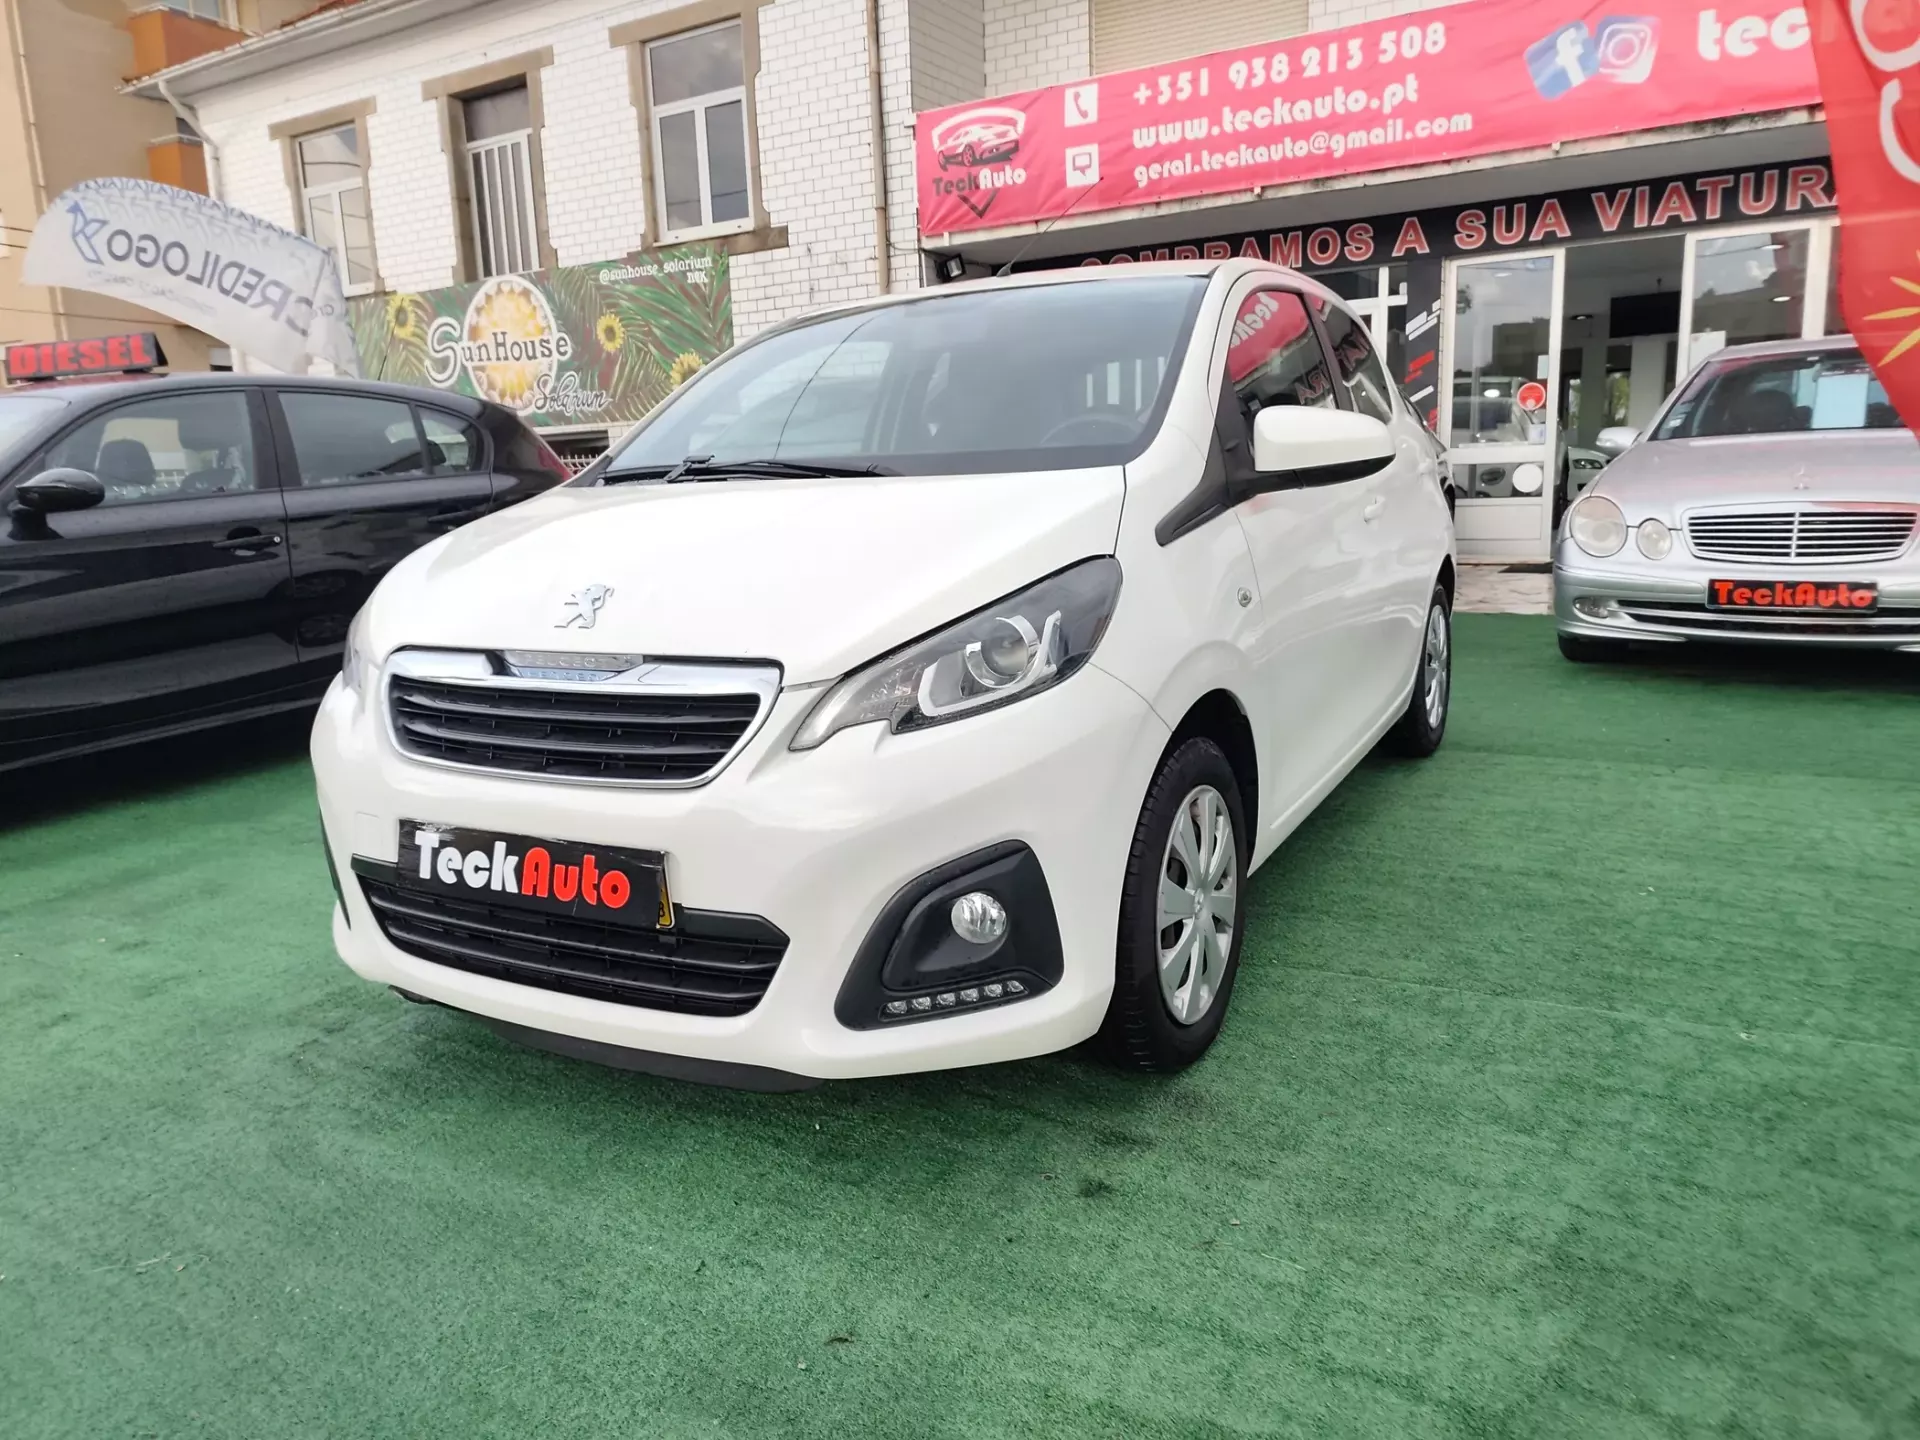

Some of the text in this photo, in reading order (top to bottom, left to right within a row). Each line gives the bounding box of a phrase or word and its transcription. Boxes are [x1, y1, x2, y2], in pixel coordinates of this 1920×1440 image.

[1133, 21, 1446, 105] +351 938 213 508
[1698, 7, 1811, 62] tec
[1132, 73, 1418, 147] www.teckauto.pt
[1134, 112, 1473, 188] geral.teckauto@gmail.com
[1392, 216, 1430, 257] A
[1454, 198, 1572, 250] SUA
[1591, 164, 1840, 233] VIATUR
[9, 334, 152, 376] DIESEL
[425, 317, 572, 387] SunHouse
[1714, 581, 1874, 608] TeckAuto
[414, 830, 631, 909] TeckAuto
